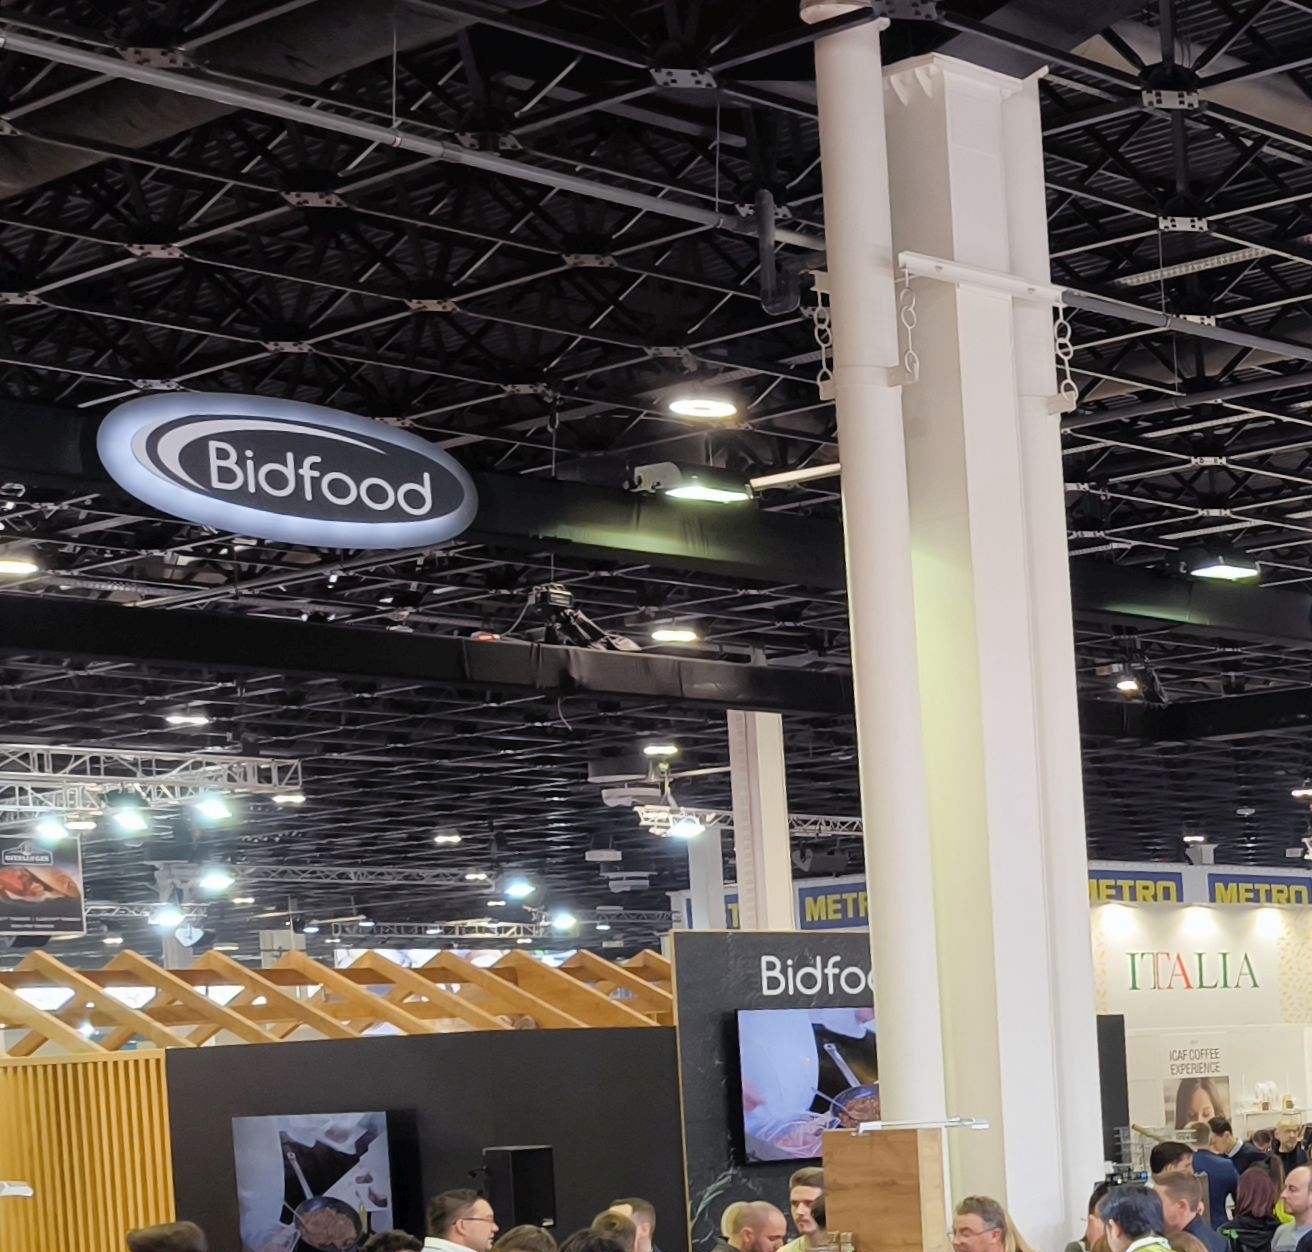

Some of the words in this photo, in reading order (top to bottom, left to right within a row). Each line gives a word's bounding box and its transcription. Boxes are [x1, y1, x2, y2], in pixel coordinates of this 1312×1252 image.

[208, 440, 433, 516] Bidfood
[1215, 882, 1309, 904] METRO
[761, 955, 875, 995] Bidfo
[1126, 951, 1260, 991] ITALIA
[1170, 1061, 1220, 1075] EXPERIENCE
[1189, 1048, 1220, 1060] COFFEE
